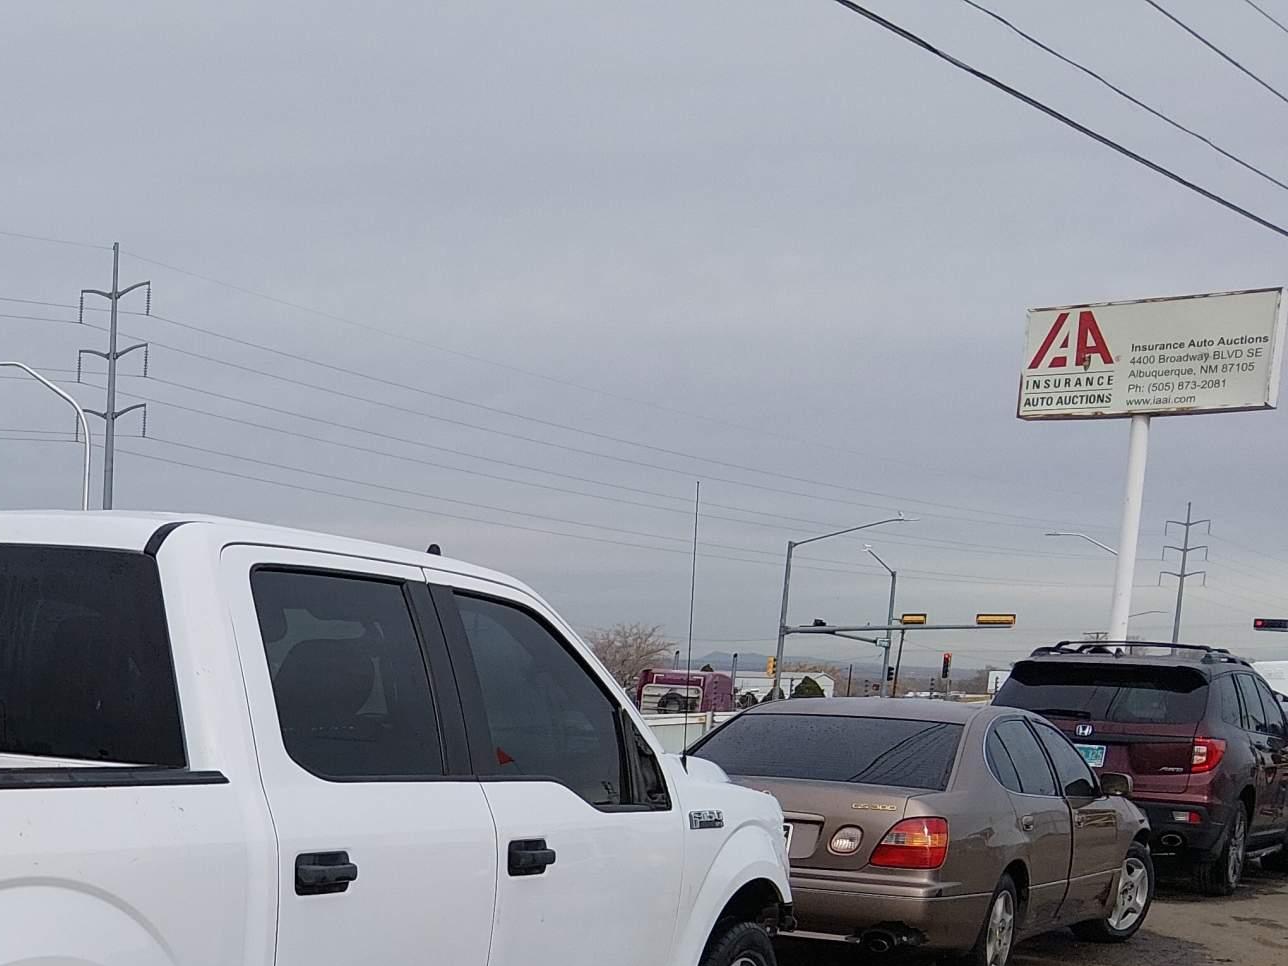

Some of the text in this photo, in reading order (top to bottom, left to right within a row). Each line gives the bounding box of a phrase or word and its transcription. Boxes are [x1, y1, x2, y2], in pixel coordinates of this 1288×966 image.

[1131, 335, 1270, 353] Insurance Auto Auctions
[1129, 347, 1264, 366] 4400 Broadway BLVD SE
[1127, 361, 1255, 379] Albuquerque, NM 87105
[1025, 375, 1114, 391] INSURANCE
[1127, 378, 1227, 393] Ph: (505) 873-2081
[1023, 392, 1112, 407] AUTO AUCTIONS
[1125, 394, 1196, 406] www.iaai.com
